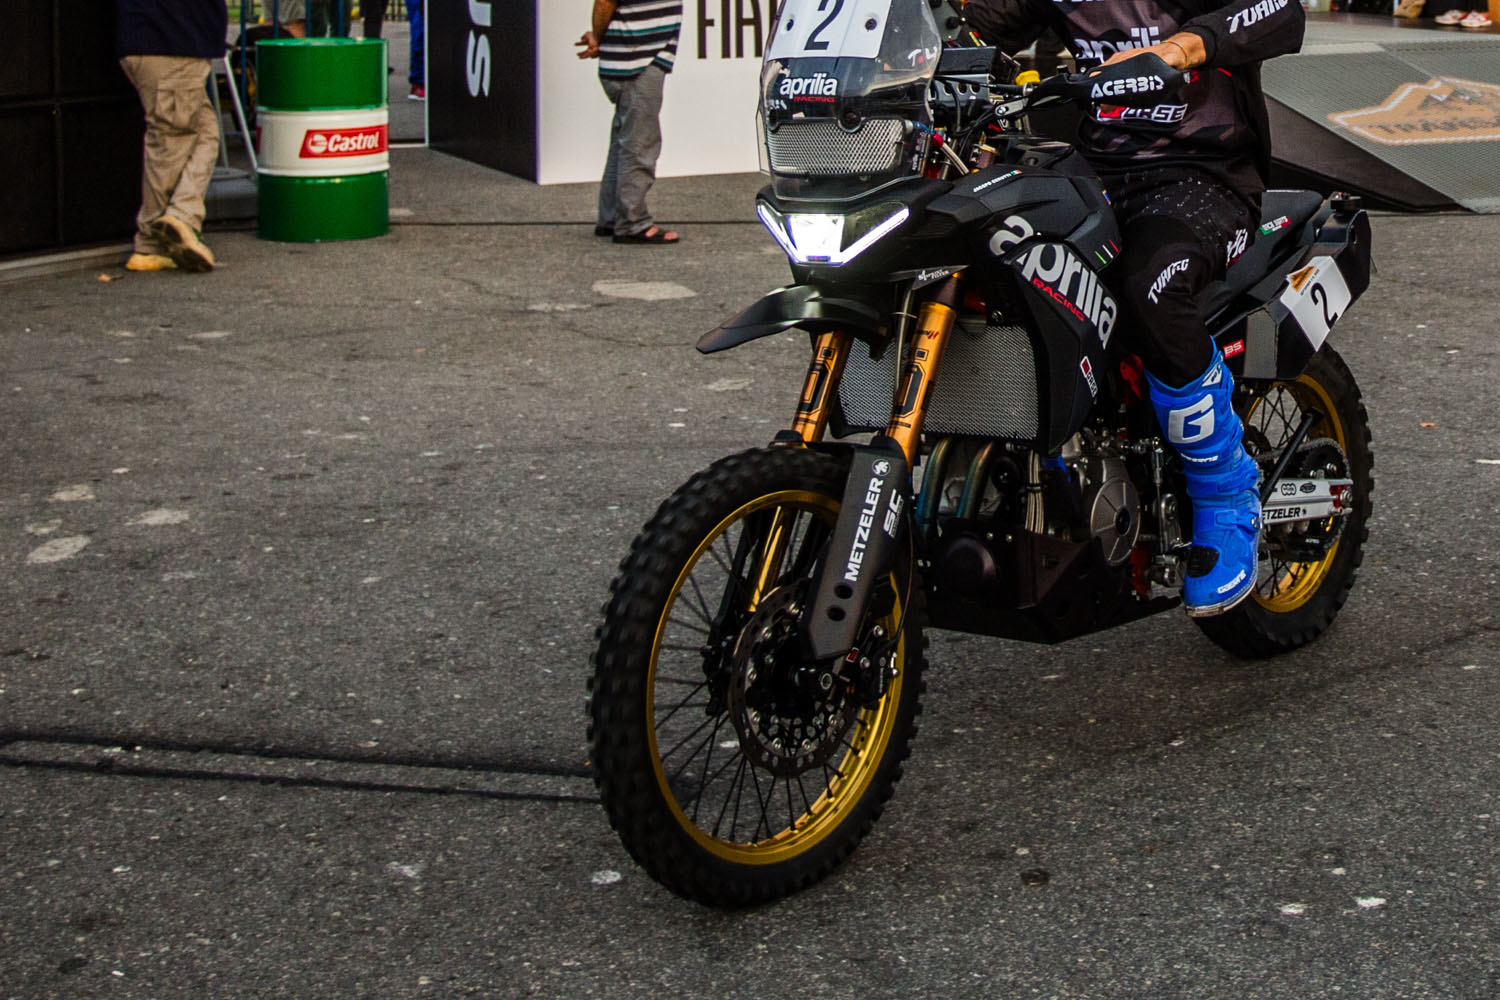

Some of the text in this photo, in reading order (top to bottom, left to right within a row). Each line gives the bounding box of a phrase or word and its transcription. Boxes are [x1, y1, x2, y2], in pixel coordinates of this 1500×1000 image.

[780, 73, 838, 99] aprilia
[328, 132, 380, 153] Castrol
[989, 215, 1117, 350] aprilia
[1033, 277, 1085, 322] RACING
[1310, 282, 1338, 331] 2
[844, 477, 884, 582] METZELER
[1262, 506, 1301, 521] ETZELER
